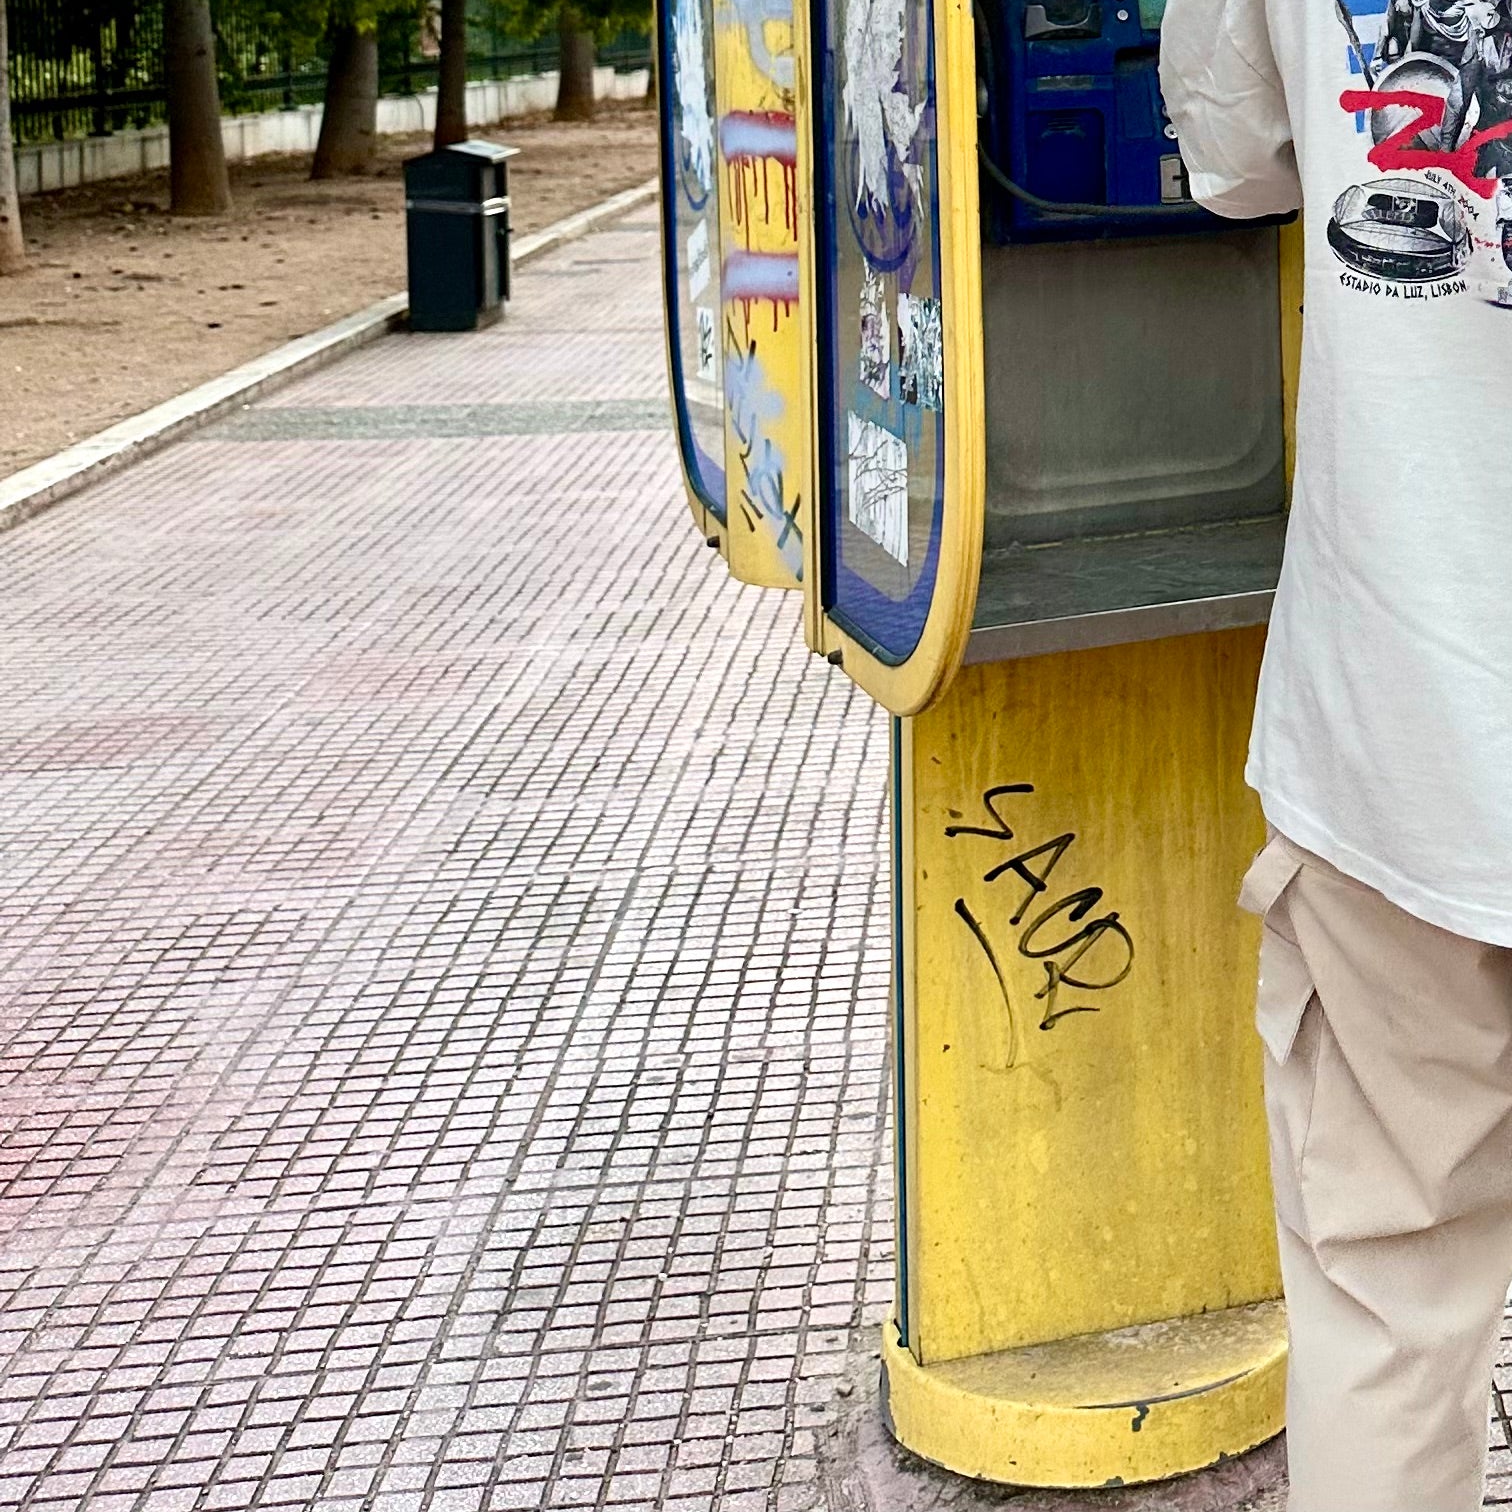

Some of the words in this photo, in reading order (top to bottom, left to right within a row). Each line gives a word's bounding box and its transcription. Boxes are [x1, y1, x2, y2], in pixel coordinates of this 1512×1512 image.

[1339, 272, 1381, 296] ESTADIO
[1385, 284, 1400, 298] DA
[1403, 285, 1428, 300] LUZ,
[1430, 280, 1468, 298] LISBON
